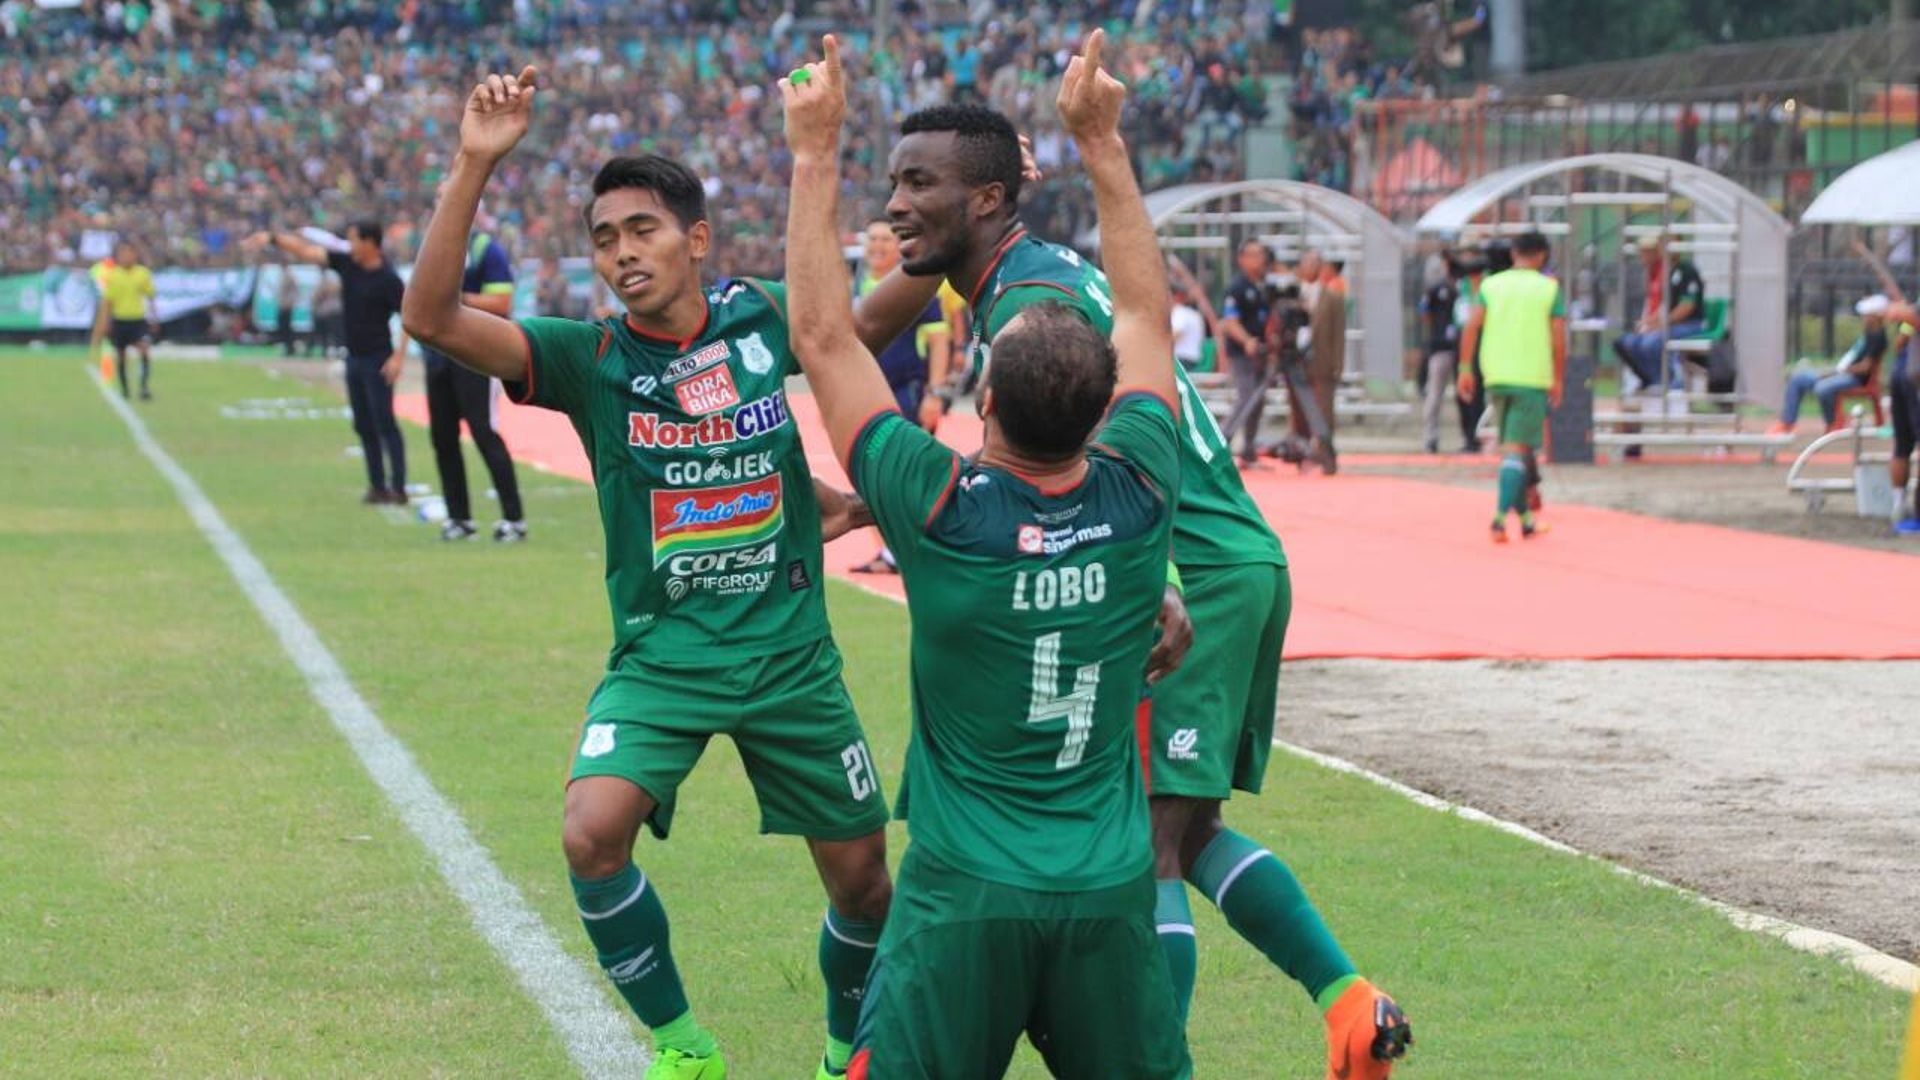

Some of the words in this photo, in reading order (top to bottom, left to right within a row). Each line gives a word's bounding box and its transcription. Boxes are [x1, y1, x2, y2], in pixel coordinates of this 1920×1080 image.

[680, 373, 728, 399] TORA
[688, 388, 733, 412] BIKA
[664, 461, 702, 485] GO
[733, 450, 774, 479] JEK
[1012, 562, 1106, 611] LOBO
[1027, 631, 1103, 770] 4
[841, 740, 877, 801] 21
